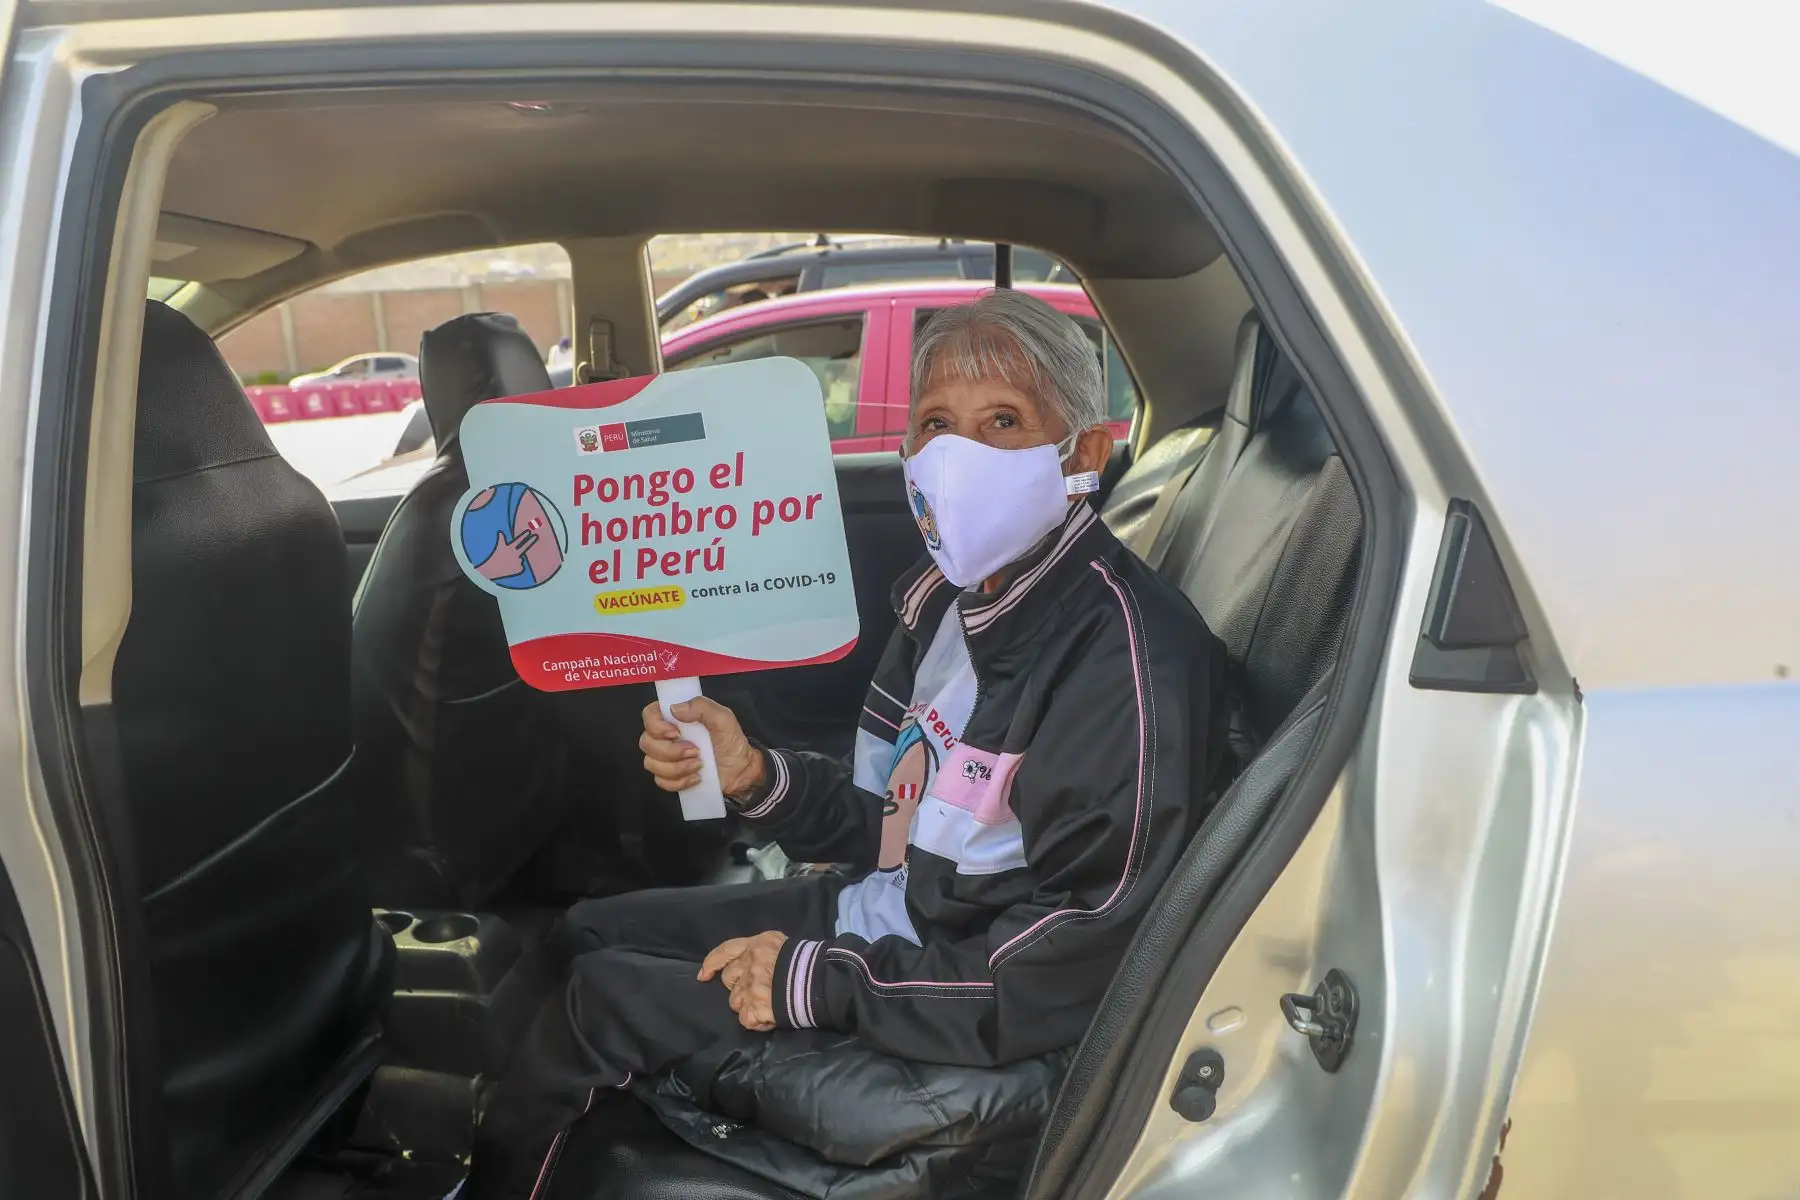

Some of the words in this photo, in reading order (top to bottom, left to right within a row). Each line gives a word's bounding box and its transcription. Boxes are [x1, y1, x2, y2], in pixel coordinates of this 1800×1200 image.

[604, 431, 624, 442] PERÚ
[631, 428, 661, 437] Ministerio
[640, 435, 657, 443] Salud
[573, 467, 695, 507] Pongo
[709, 451, 744, 489] el
[581, 501, 737, 546] hombro
[752, 492, 823, 536] por
[588, 549, 621, 585] el
[636, 537, 726, 580] Perú
[597, 590, 681, 610] VACÚNATE
[691, 583, 742, 599] contra
[745, 580, 760, 593] la
[763, 571, 836, 591] COVID-19
[542, 656, 600, 672] Campaña
[603, 650, 658, 666] Nacional
[564, 671, 580, 682] de
[583, 663, 657, 681] Vacunación
